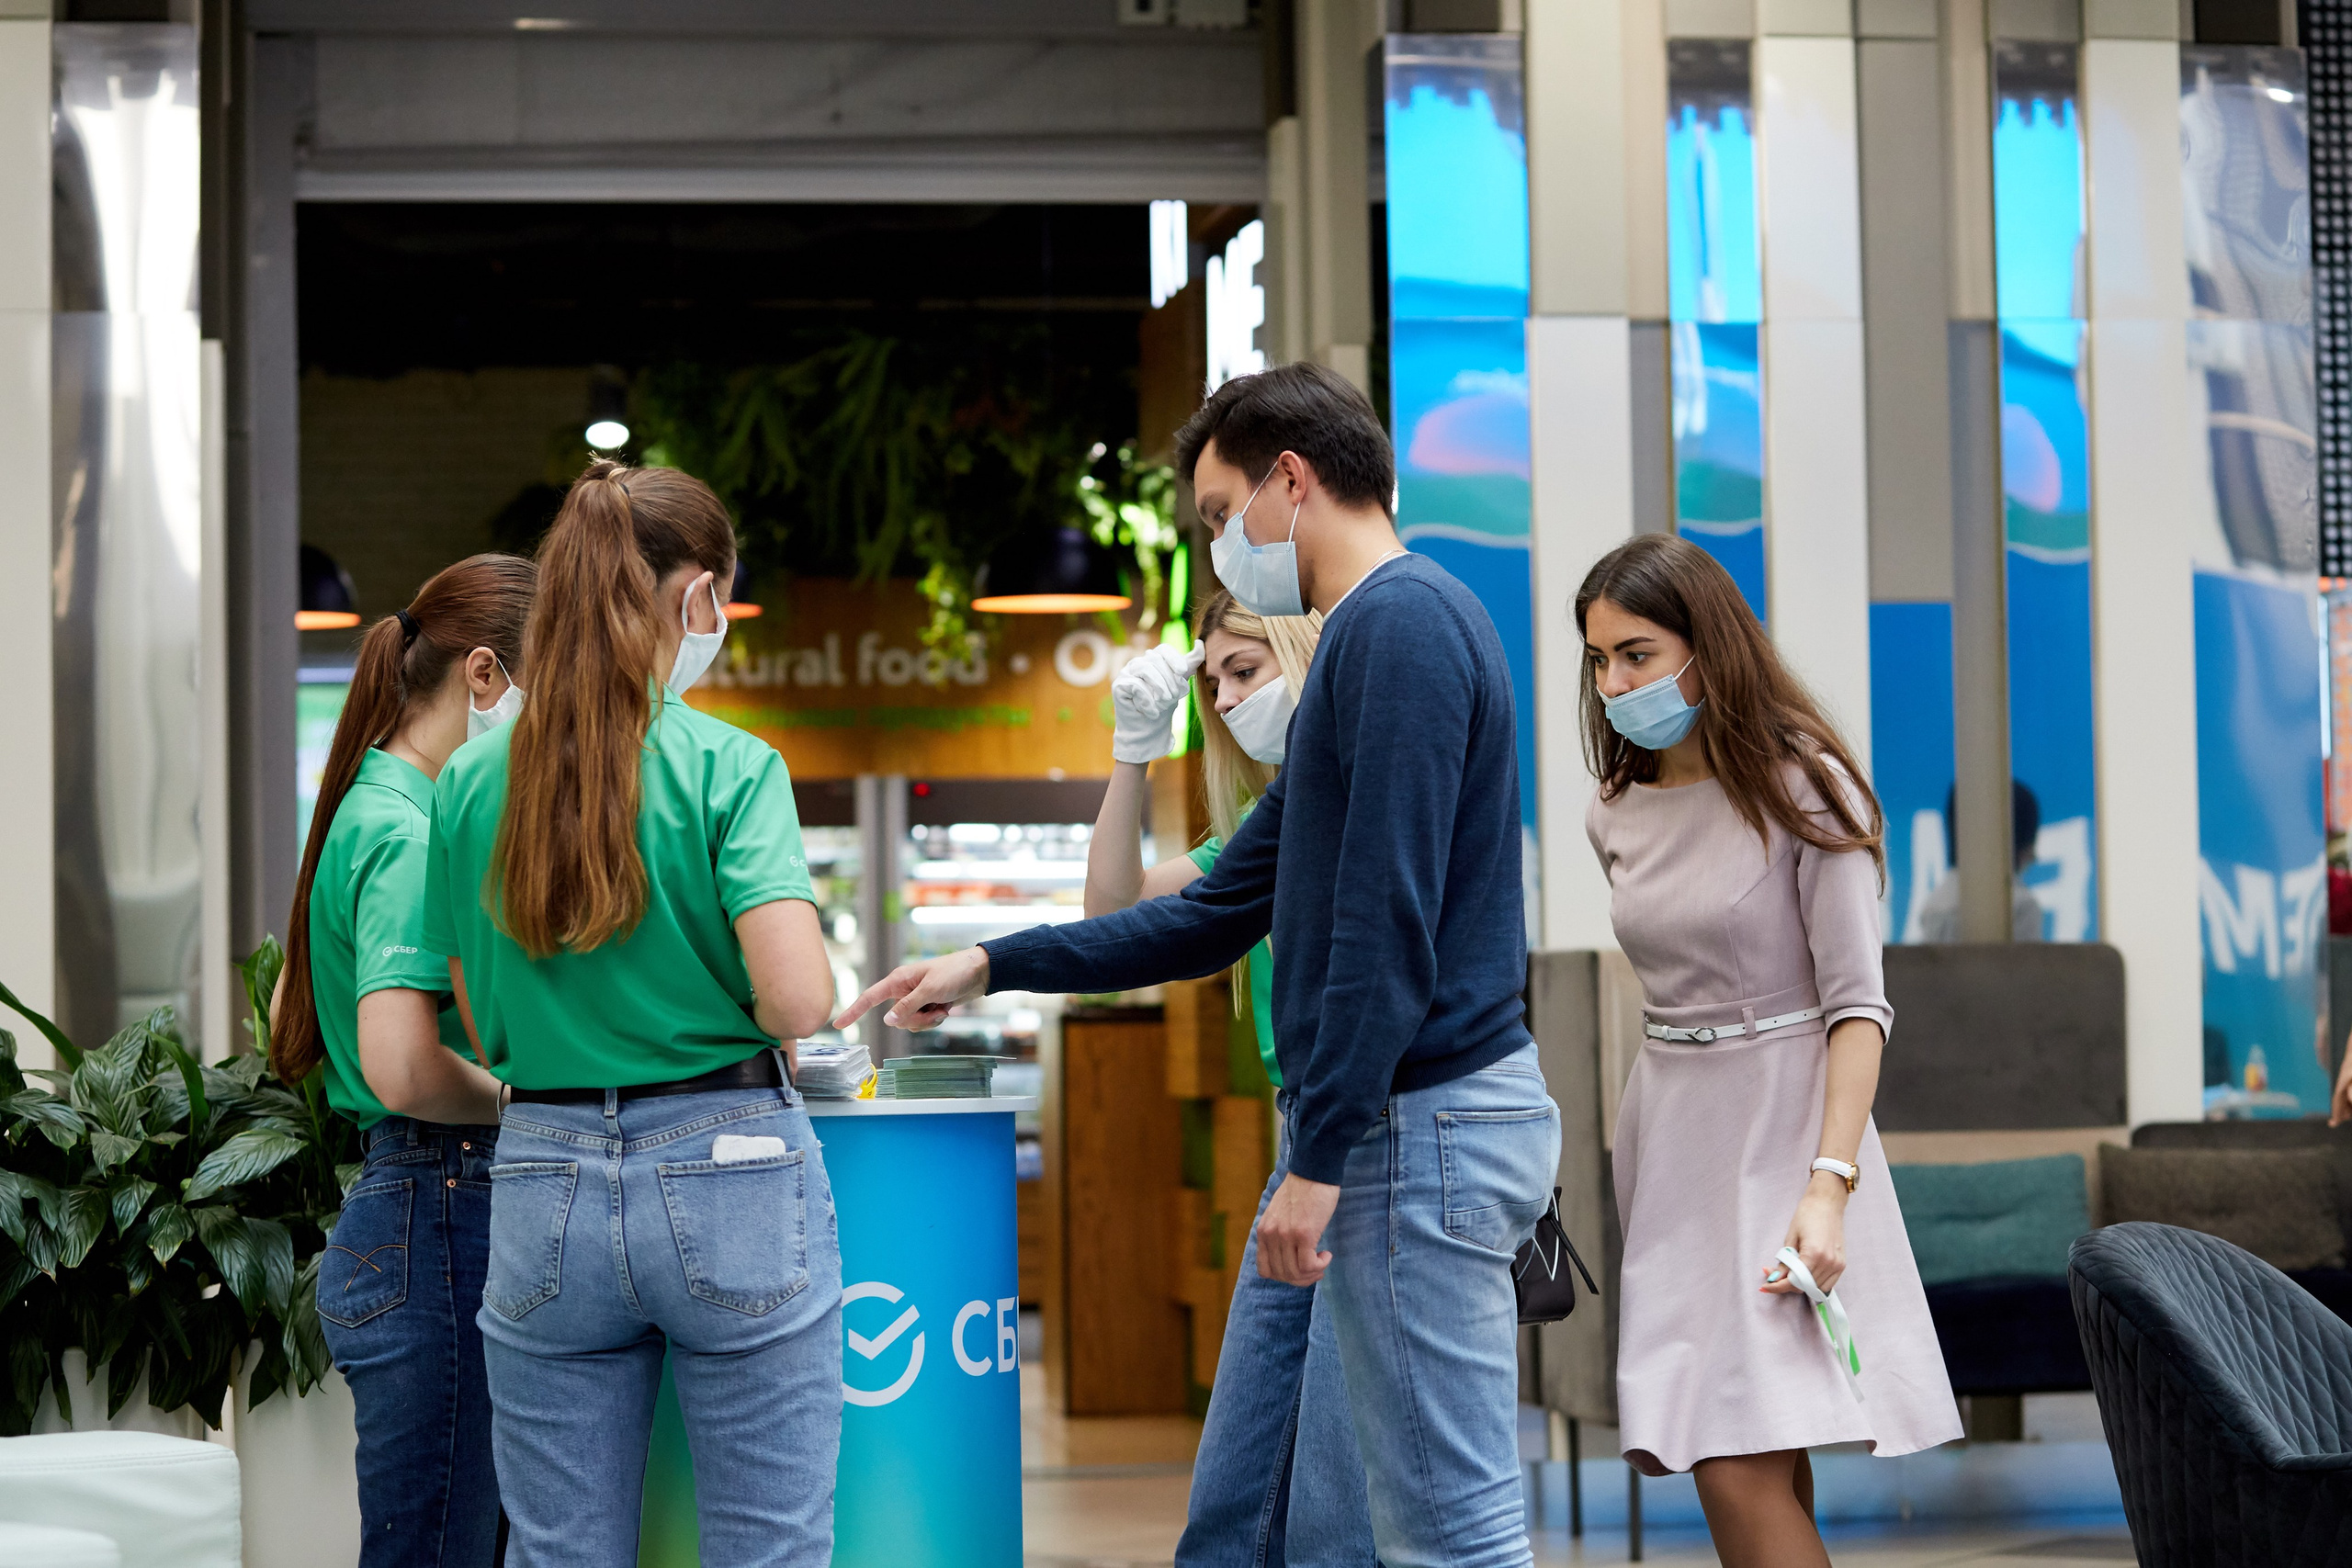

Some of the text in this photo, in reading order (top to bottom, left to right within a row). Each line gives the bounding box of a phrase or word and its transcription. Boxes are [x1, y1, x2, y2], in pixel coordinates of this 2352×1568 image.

[857, 631, 989, 687] food
[393, 945, 418, 954] СБЕР
[952, 1295, 1021, 1377] СБ
